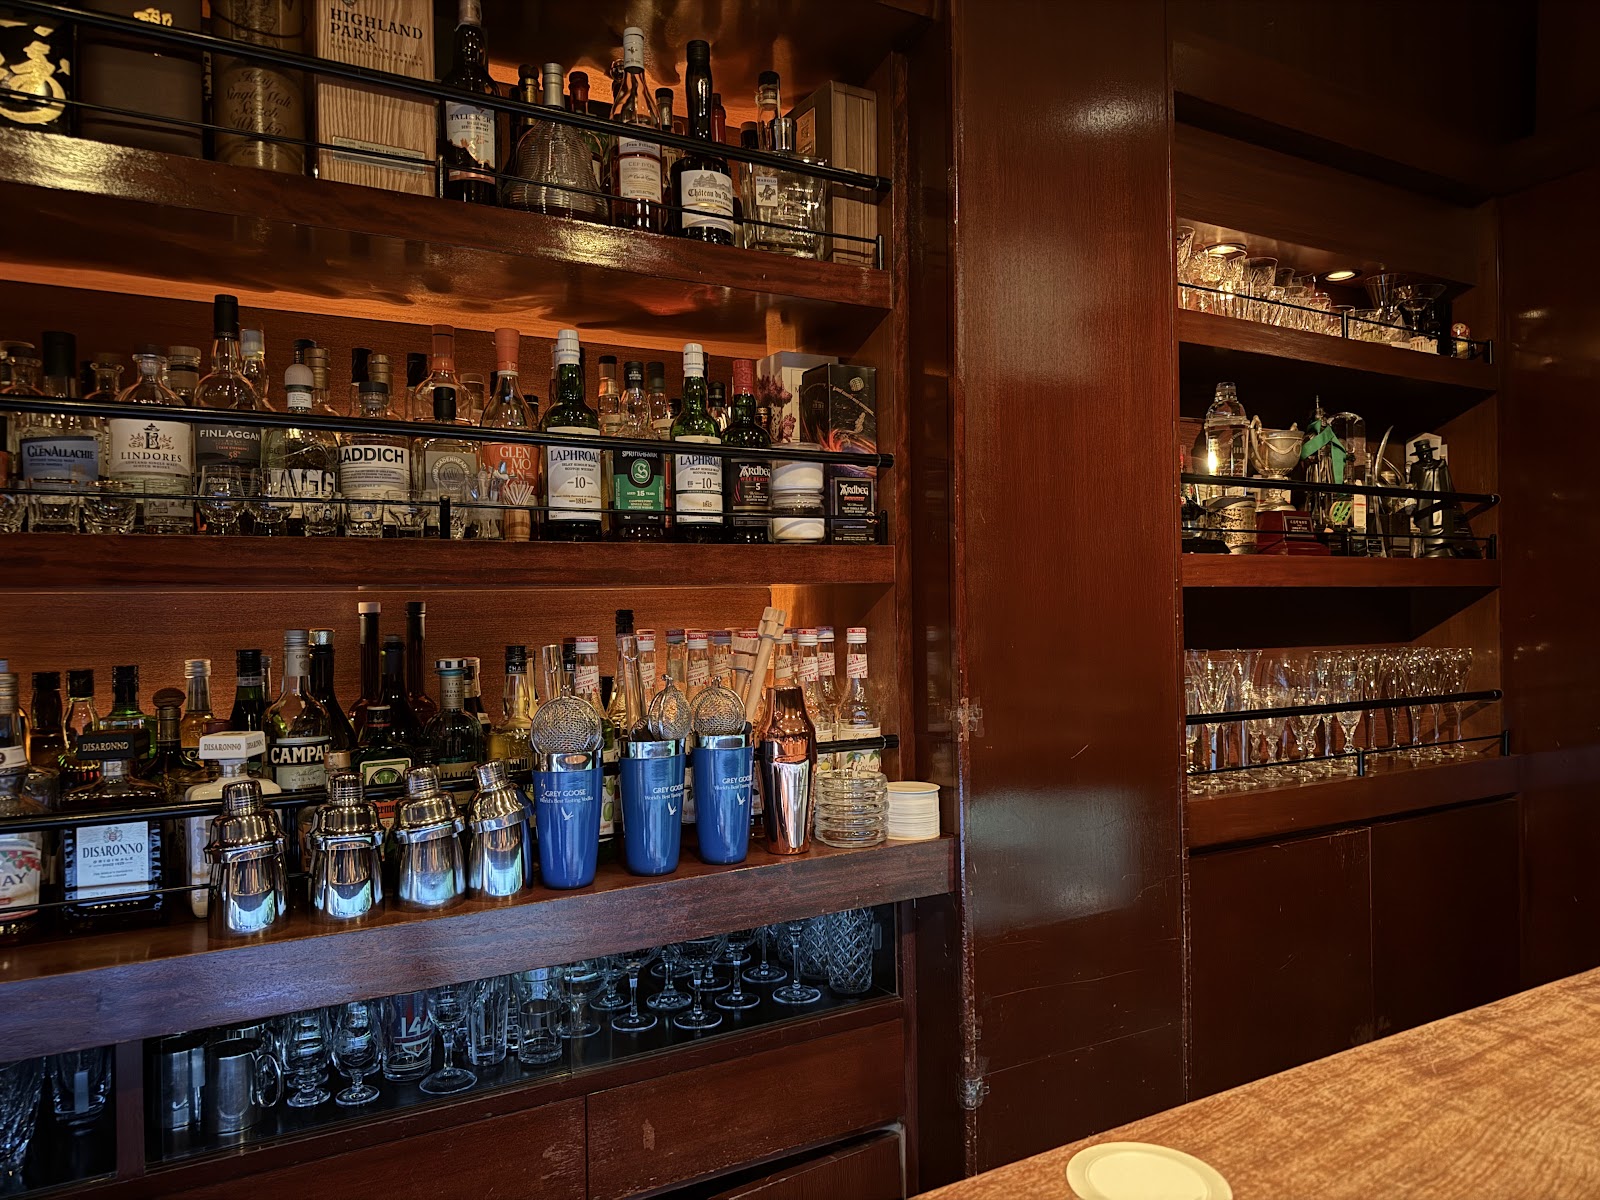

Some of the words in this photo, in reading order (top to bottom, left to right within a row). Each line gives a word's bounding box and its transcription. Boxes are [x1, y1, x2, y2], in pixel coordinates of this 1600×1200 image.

[331, 8, 422, 40] HIGHLAND
[331, 22, 376, 44] PARK
[200, 430, 260, 441] FINLAGGAN
[121, 452, 182, 462] LINDORES
[340, 448, 404, 464] ADDICH
[500, 446, 531, 459] GLEN
[550, 450, 600, 463] LAPHROA
[512, 458, 531, 470] MO
[575, 476, 586, 488] 10
[702, 478, 712, 489] 10
[82, 741, 129, 752] DISARONNO
[204, 743, 242, 751] DISARONNO
[563, 788, 586, 797] GOOSE
[82, 842, 143, 858] DISARONNO
